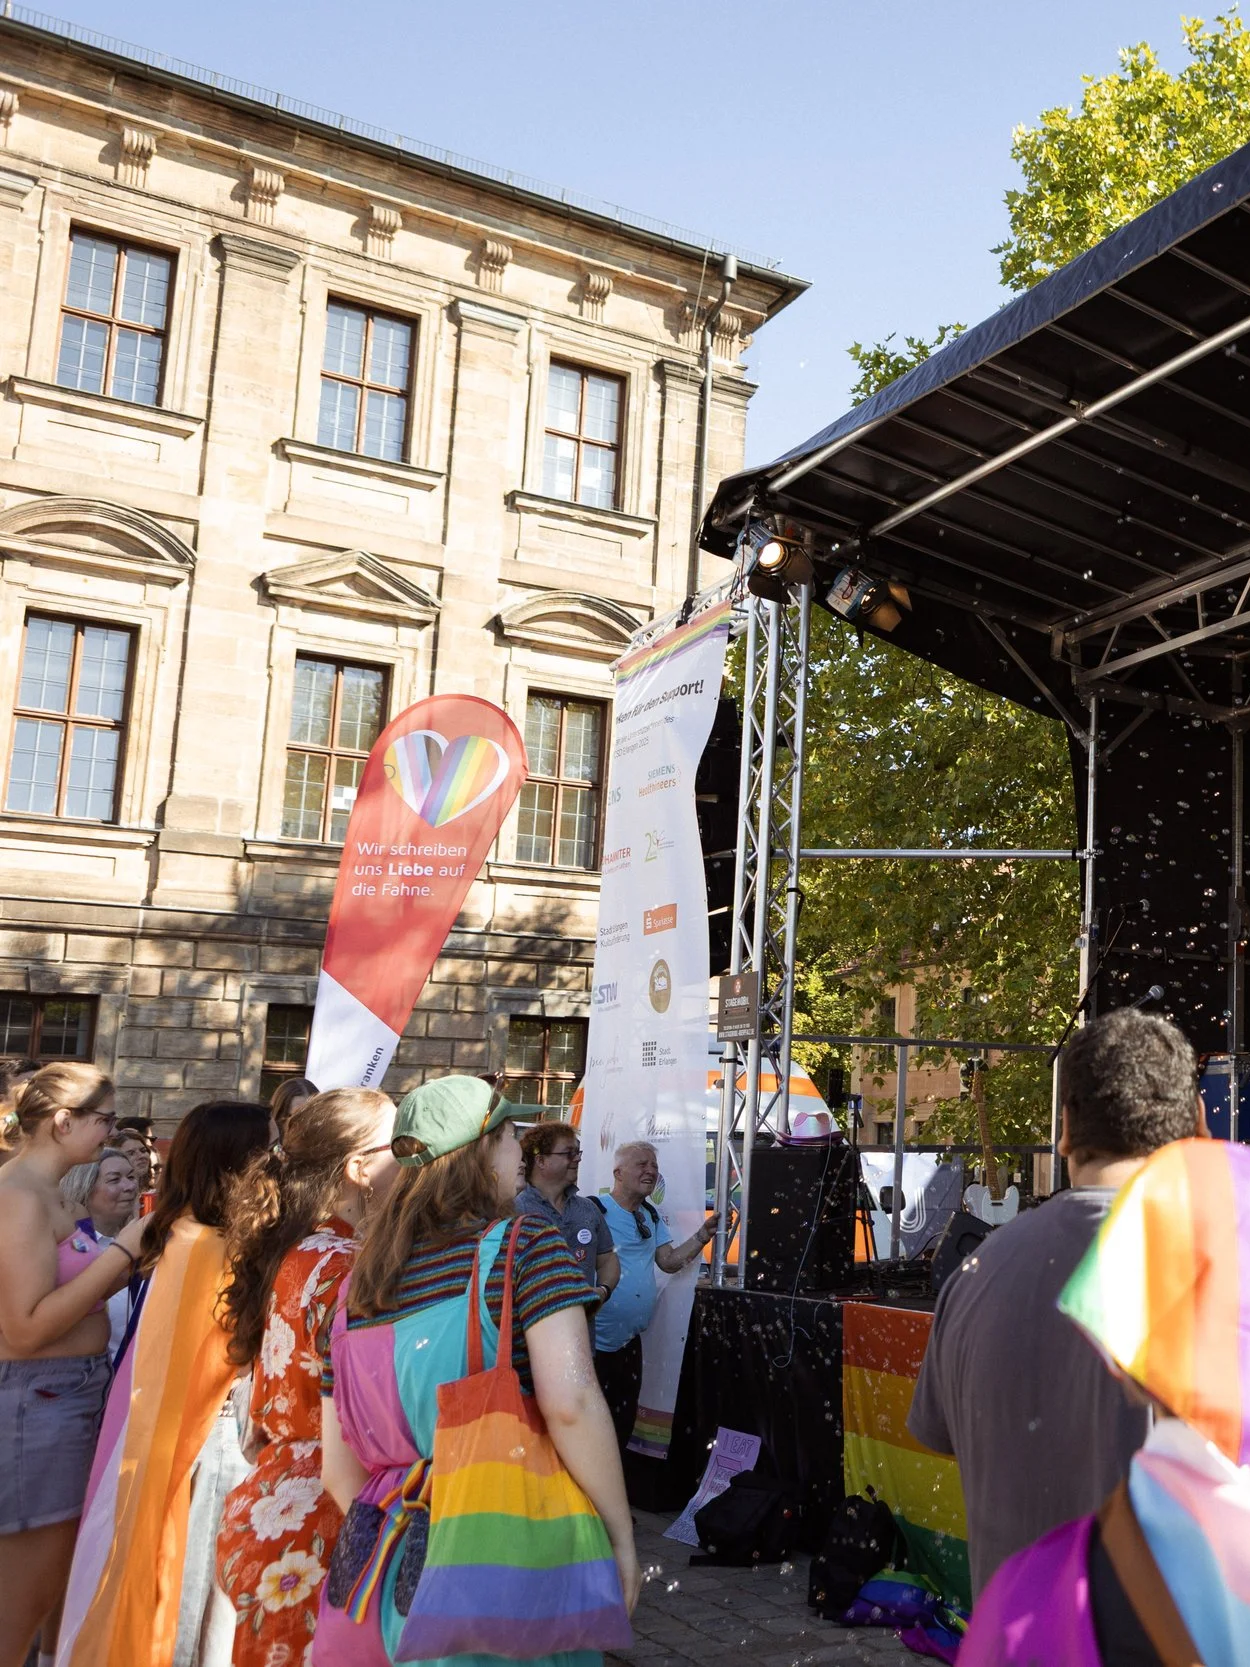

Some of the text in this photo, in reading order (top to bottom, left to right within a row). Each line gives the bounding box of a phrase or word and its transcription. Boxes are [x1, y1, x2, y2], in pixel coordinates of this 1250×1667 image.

[659, 680, 704, 704] Support!
[648, 764, 676, 780] SIEMENS
[638, 778, 677, 797] Healthineers
[357, 842, 467, 857] Wir schreiben
[354, 862, 465, 877] uns Liebe auf
[352, 882, 435, 896] die Fahne.
[358, 1047, 384, 1088] ranken
